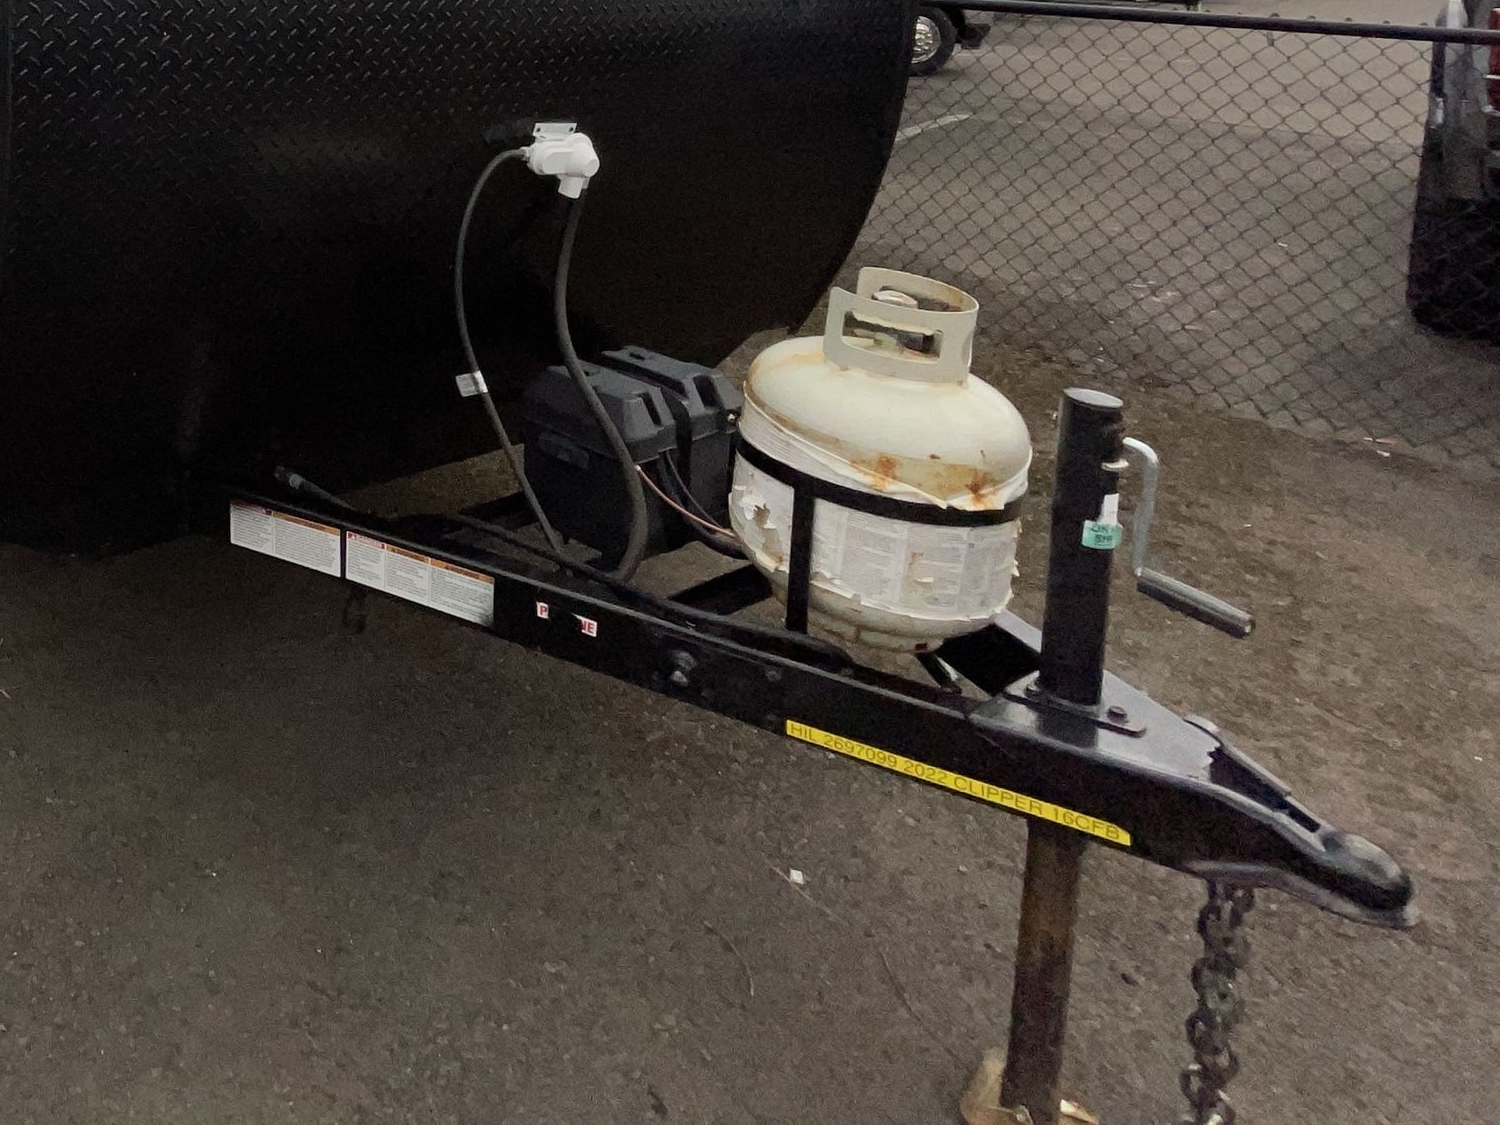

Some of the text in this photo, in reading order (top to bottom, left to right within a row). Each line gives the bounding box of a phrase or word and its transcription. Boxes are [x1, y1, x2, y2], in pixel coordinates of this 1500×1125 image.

[790, 723, 1120, 841] HIL 2697099 2022 CLIPPER 16CFB
